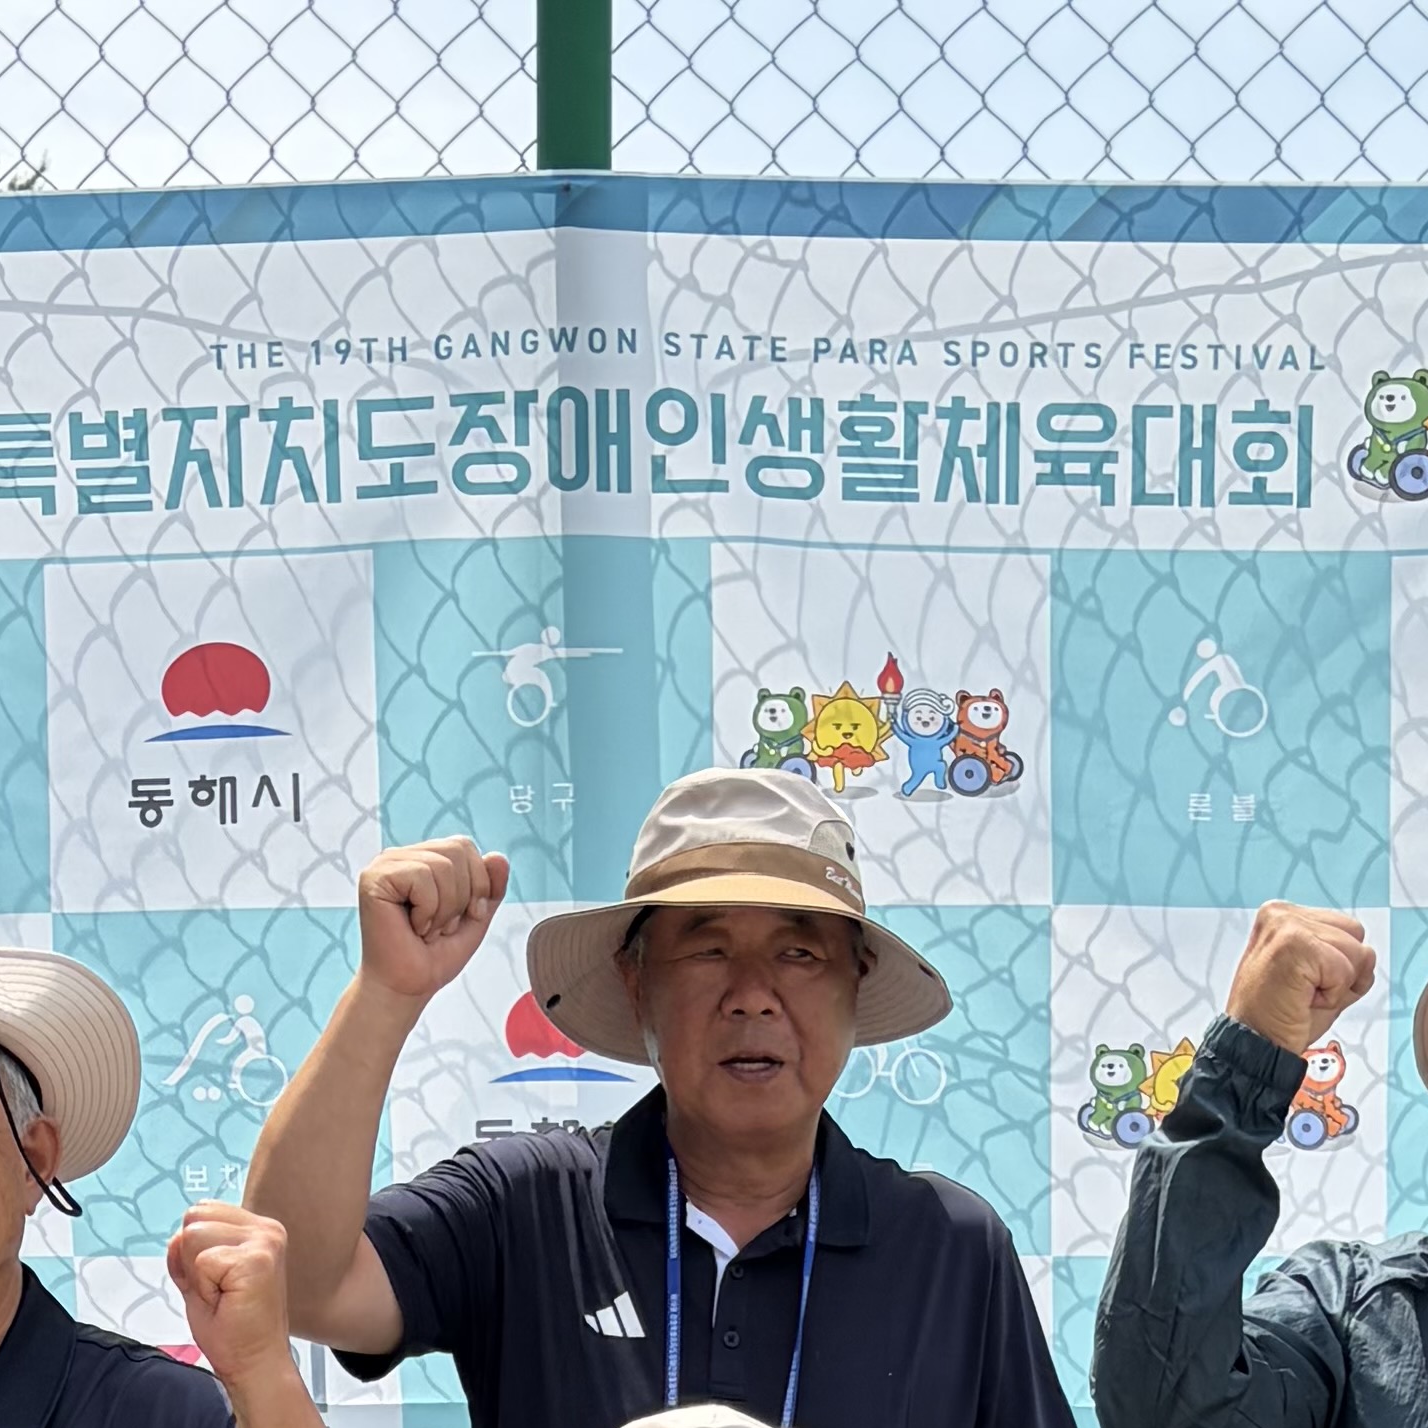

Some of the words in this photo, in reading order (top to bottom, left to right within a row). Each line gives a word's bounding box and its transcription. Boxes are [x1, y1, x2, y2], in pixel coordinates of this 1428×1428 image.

[209, 341, 284, 371] THE
[310, 335, 408, 366] 19TH
[434, 327, 638, 361] GANGWON
[663, 331, 788, 364] STATE
[812, 337, 918, 367] PARA
[942, 340, 1103, 369] SPORTS
[1128, 342, 1326, 371] FESTIVAL
[128, 771, 302, 828] 동해시
